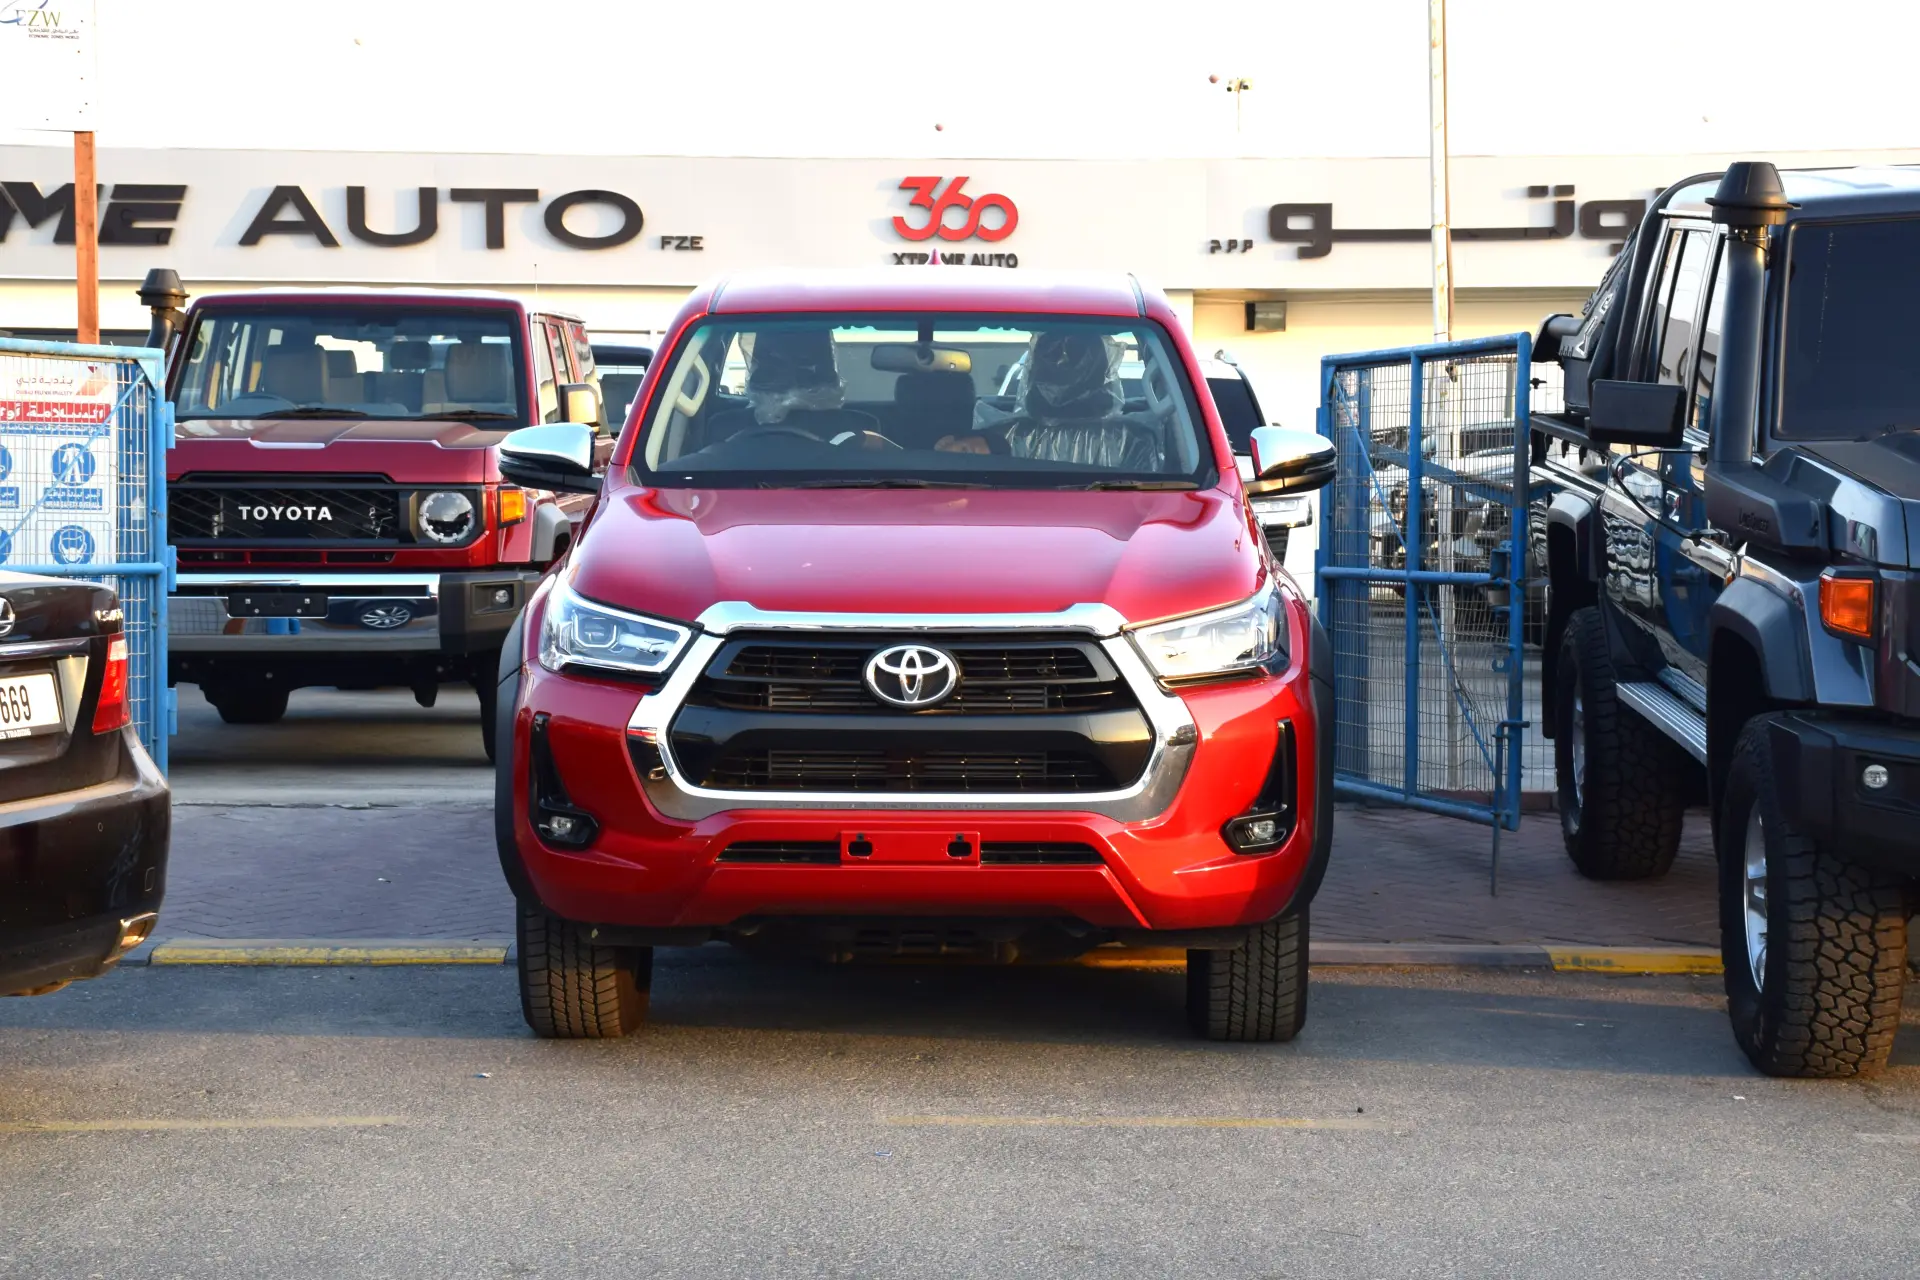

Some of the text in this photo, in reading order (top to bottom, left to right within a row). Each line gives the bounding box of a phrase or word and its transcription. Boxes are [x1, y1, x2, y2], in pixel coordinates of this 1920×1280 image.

[238, 185, 644, 250] AUTO
[661, 235, 704, 250] FZE
[892, 176, 1018, 242] 360
[971, 252, 1019, 268] AUTO
[238, 506, 332, 520] TOYOTA
